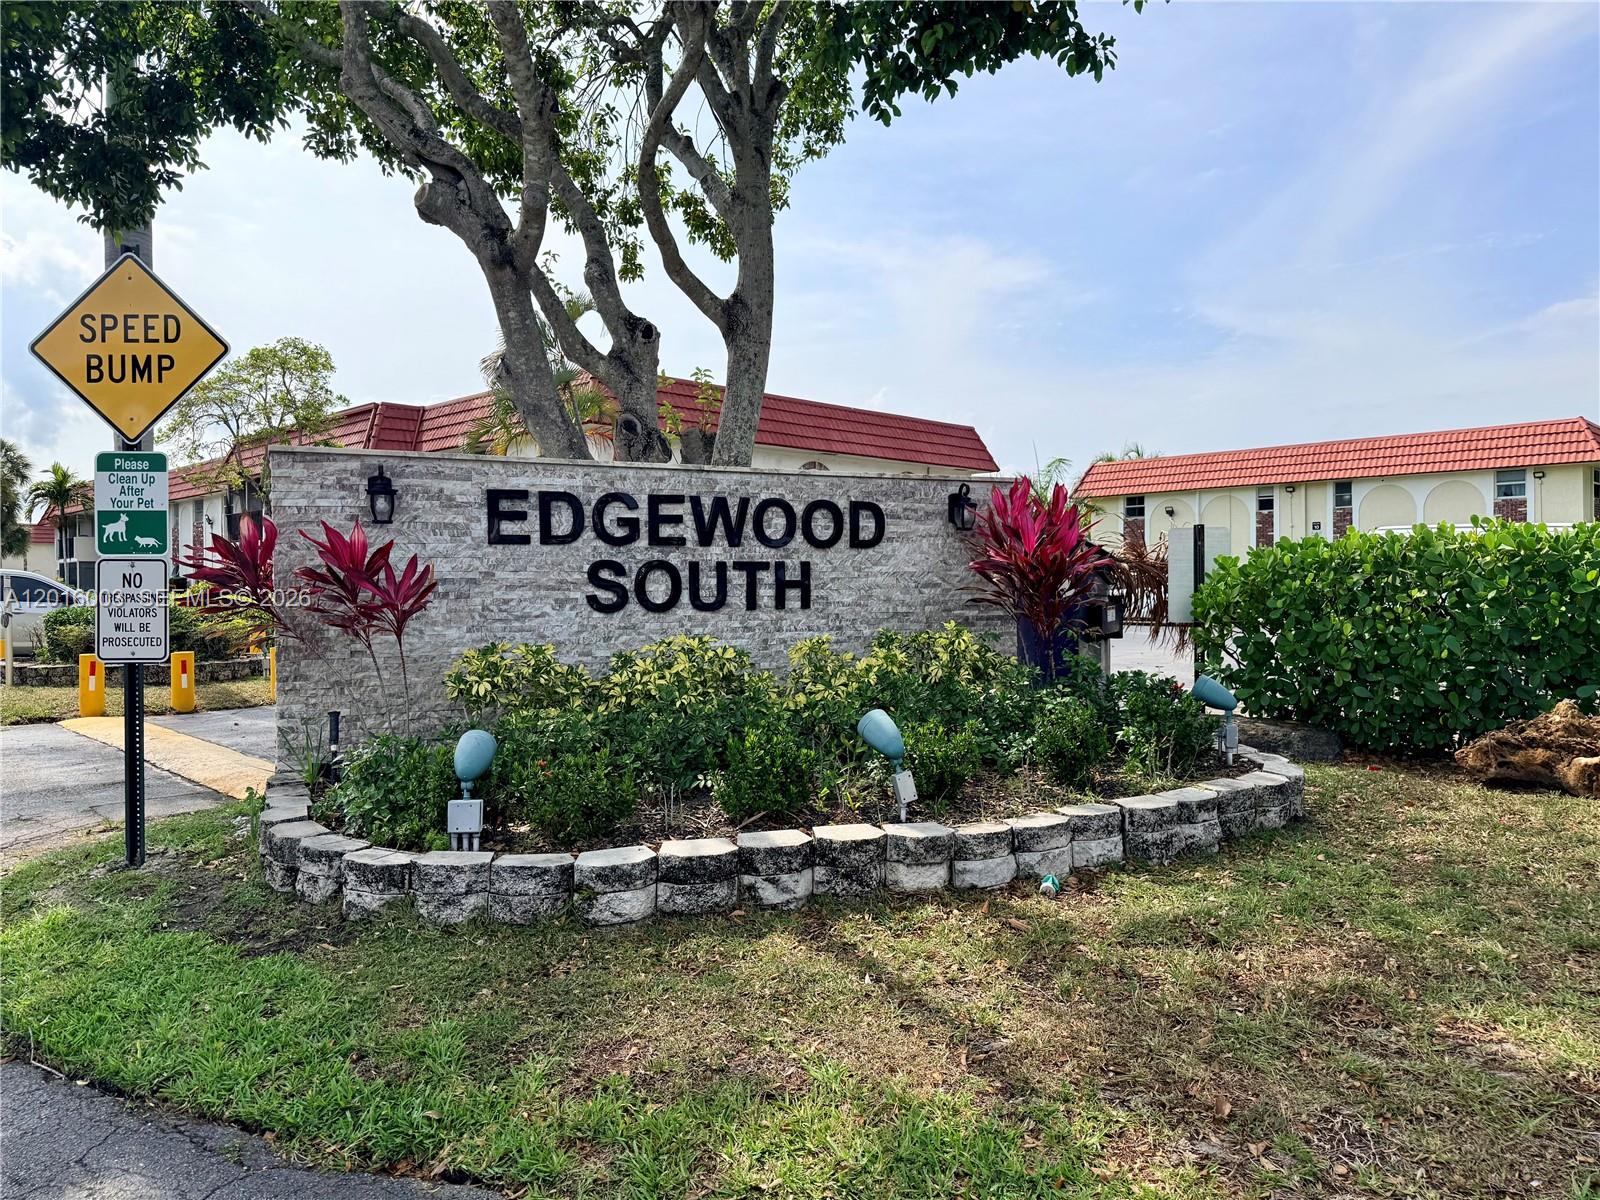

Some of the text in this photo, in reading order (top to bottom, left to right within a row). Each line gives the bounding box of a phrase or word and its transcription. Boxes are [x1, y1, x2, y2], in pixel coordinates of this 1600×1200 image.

[79, 313, 181, 343] SPEED
[86, 354, 175, 384] BUMP
[114, 458, 149, 470] Please
[108, 473, 155, 487] Clean Up
[119, 485, 144, 496] After
[111, 497, 154, 508] Your Pet
[486, 489, 886, 549] EDGEWOOD
[122, 572, 143, 588] NO
[585, 559, 811, 614] SOUTH
[102, 593, 163, 603] TRESPASSING
[108, 608, 158, 618] VIOLATORS
[114, 622, 151, 632] WILL BE
[102, 637, 162, 647] PROSECUTED
